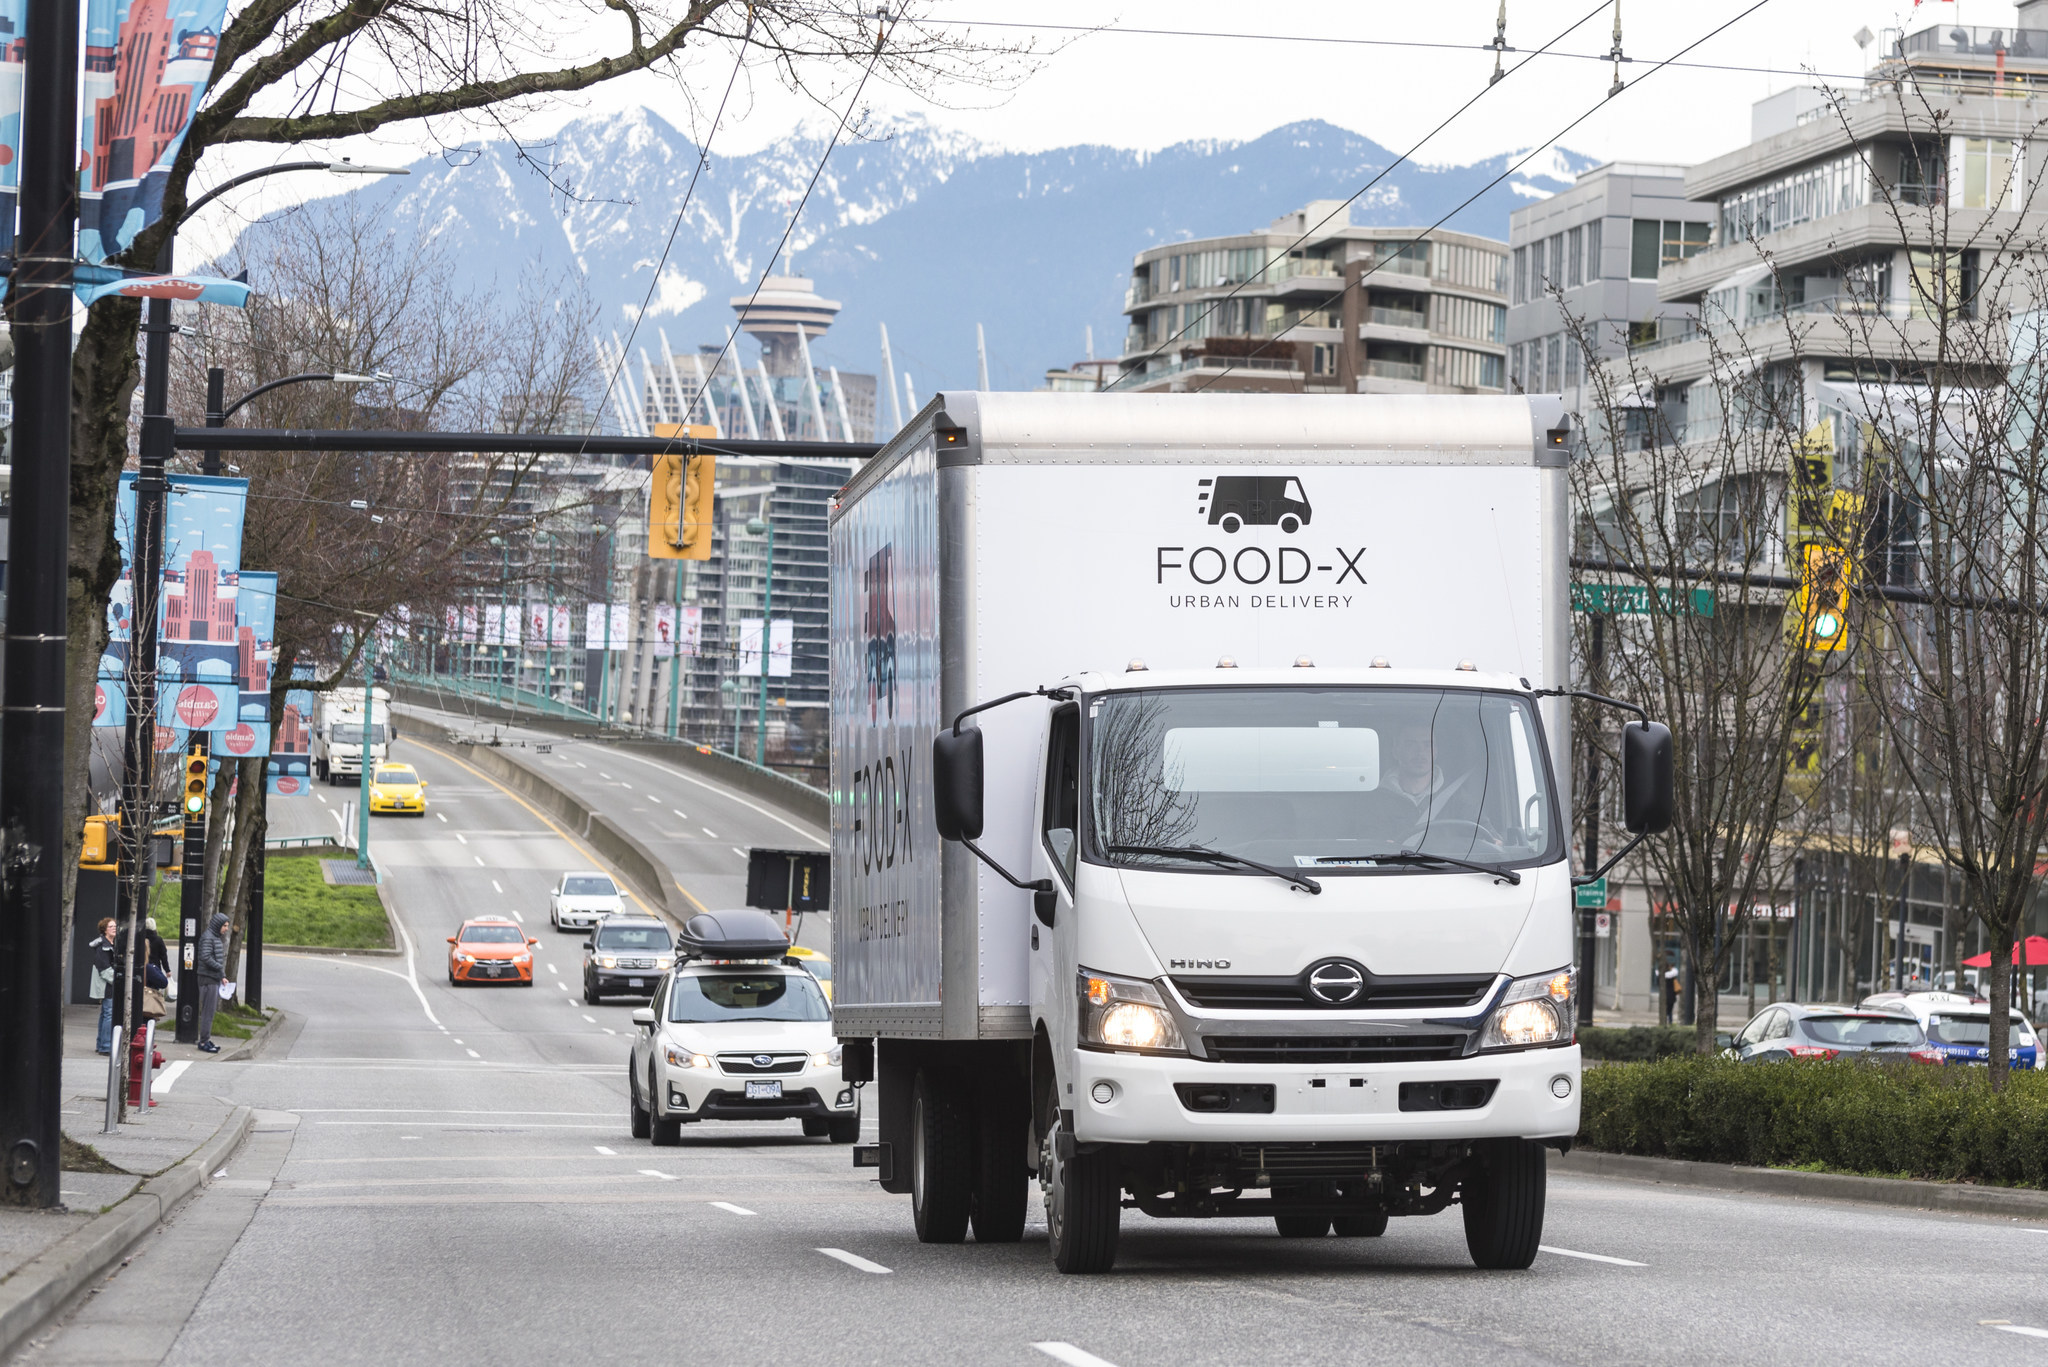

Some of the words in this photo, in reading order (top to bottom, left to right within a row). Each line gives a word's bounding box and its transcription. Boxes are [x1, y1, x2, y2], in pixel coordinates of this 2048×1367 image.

[1157, 546, 1368, 585] FOOD-X
[1169, 595, 1240, 609] URBAN
[1251, 595, 1353, 609] DELIVERY
[854, 746, 912, 878] FOOD-X
[1170, 958, 1231, 970] HINO
